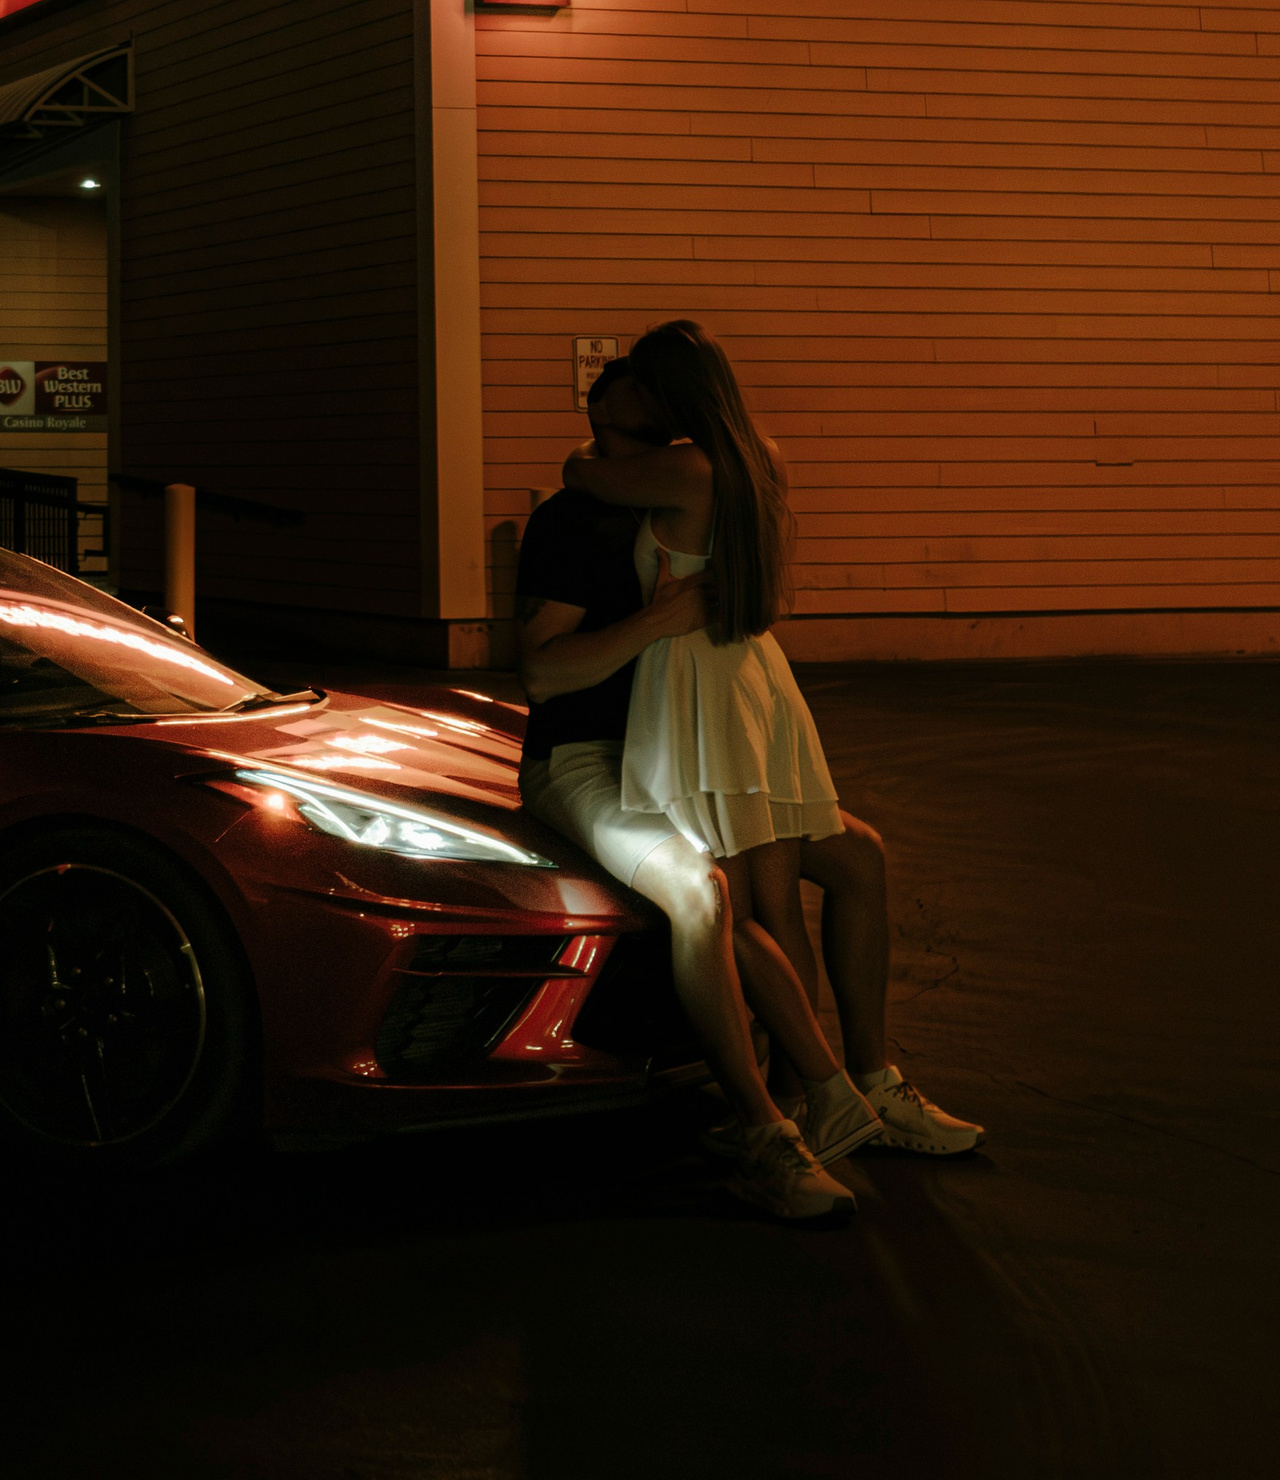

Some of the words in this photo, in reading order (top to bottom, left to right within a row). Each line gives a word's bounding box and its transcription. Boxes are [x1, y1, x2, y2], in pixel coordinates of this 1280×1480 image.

[590, 340, 603, 354] NO
[57, 367, 89, 380] Best
[44, 380, 102, 393] Western
[54, 395, 92, 408] PLUS
[4, 416, 44, 428] Casino
[47, 417, 87, 430] Royale
